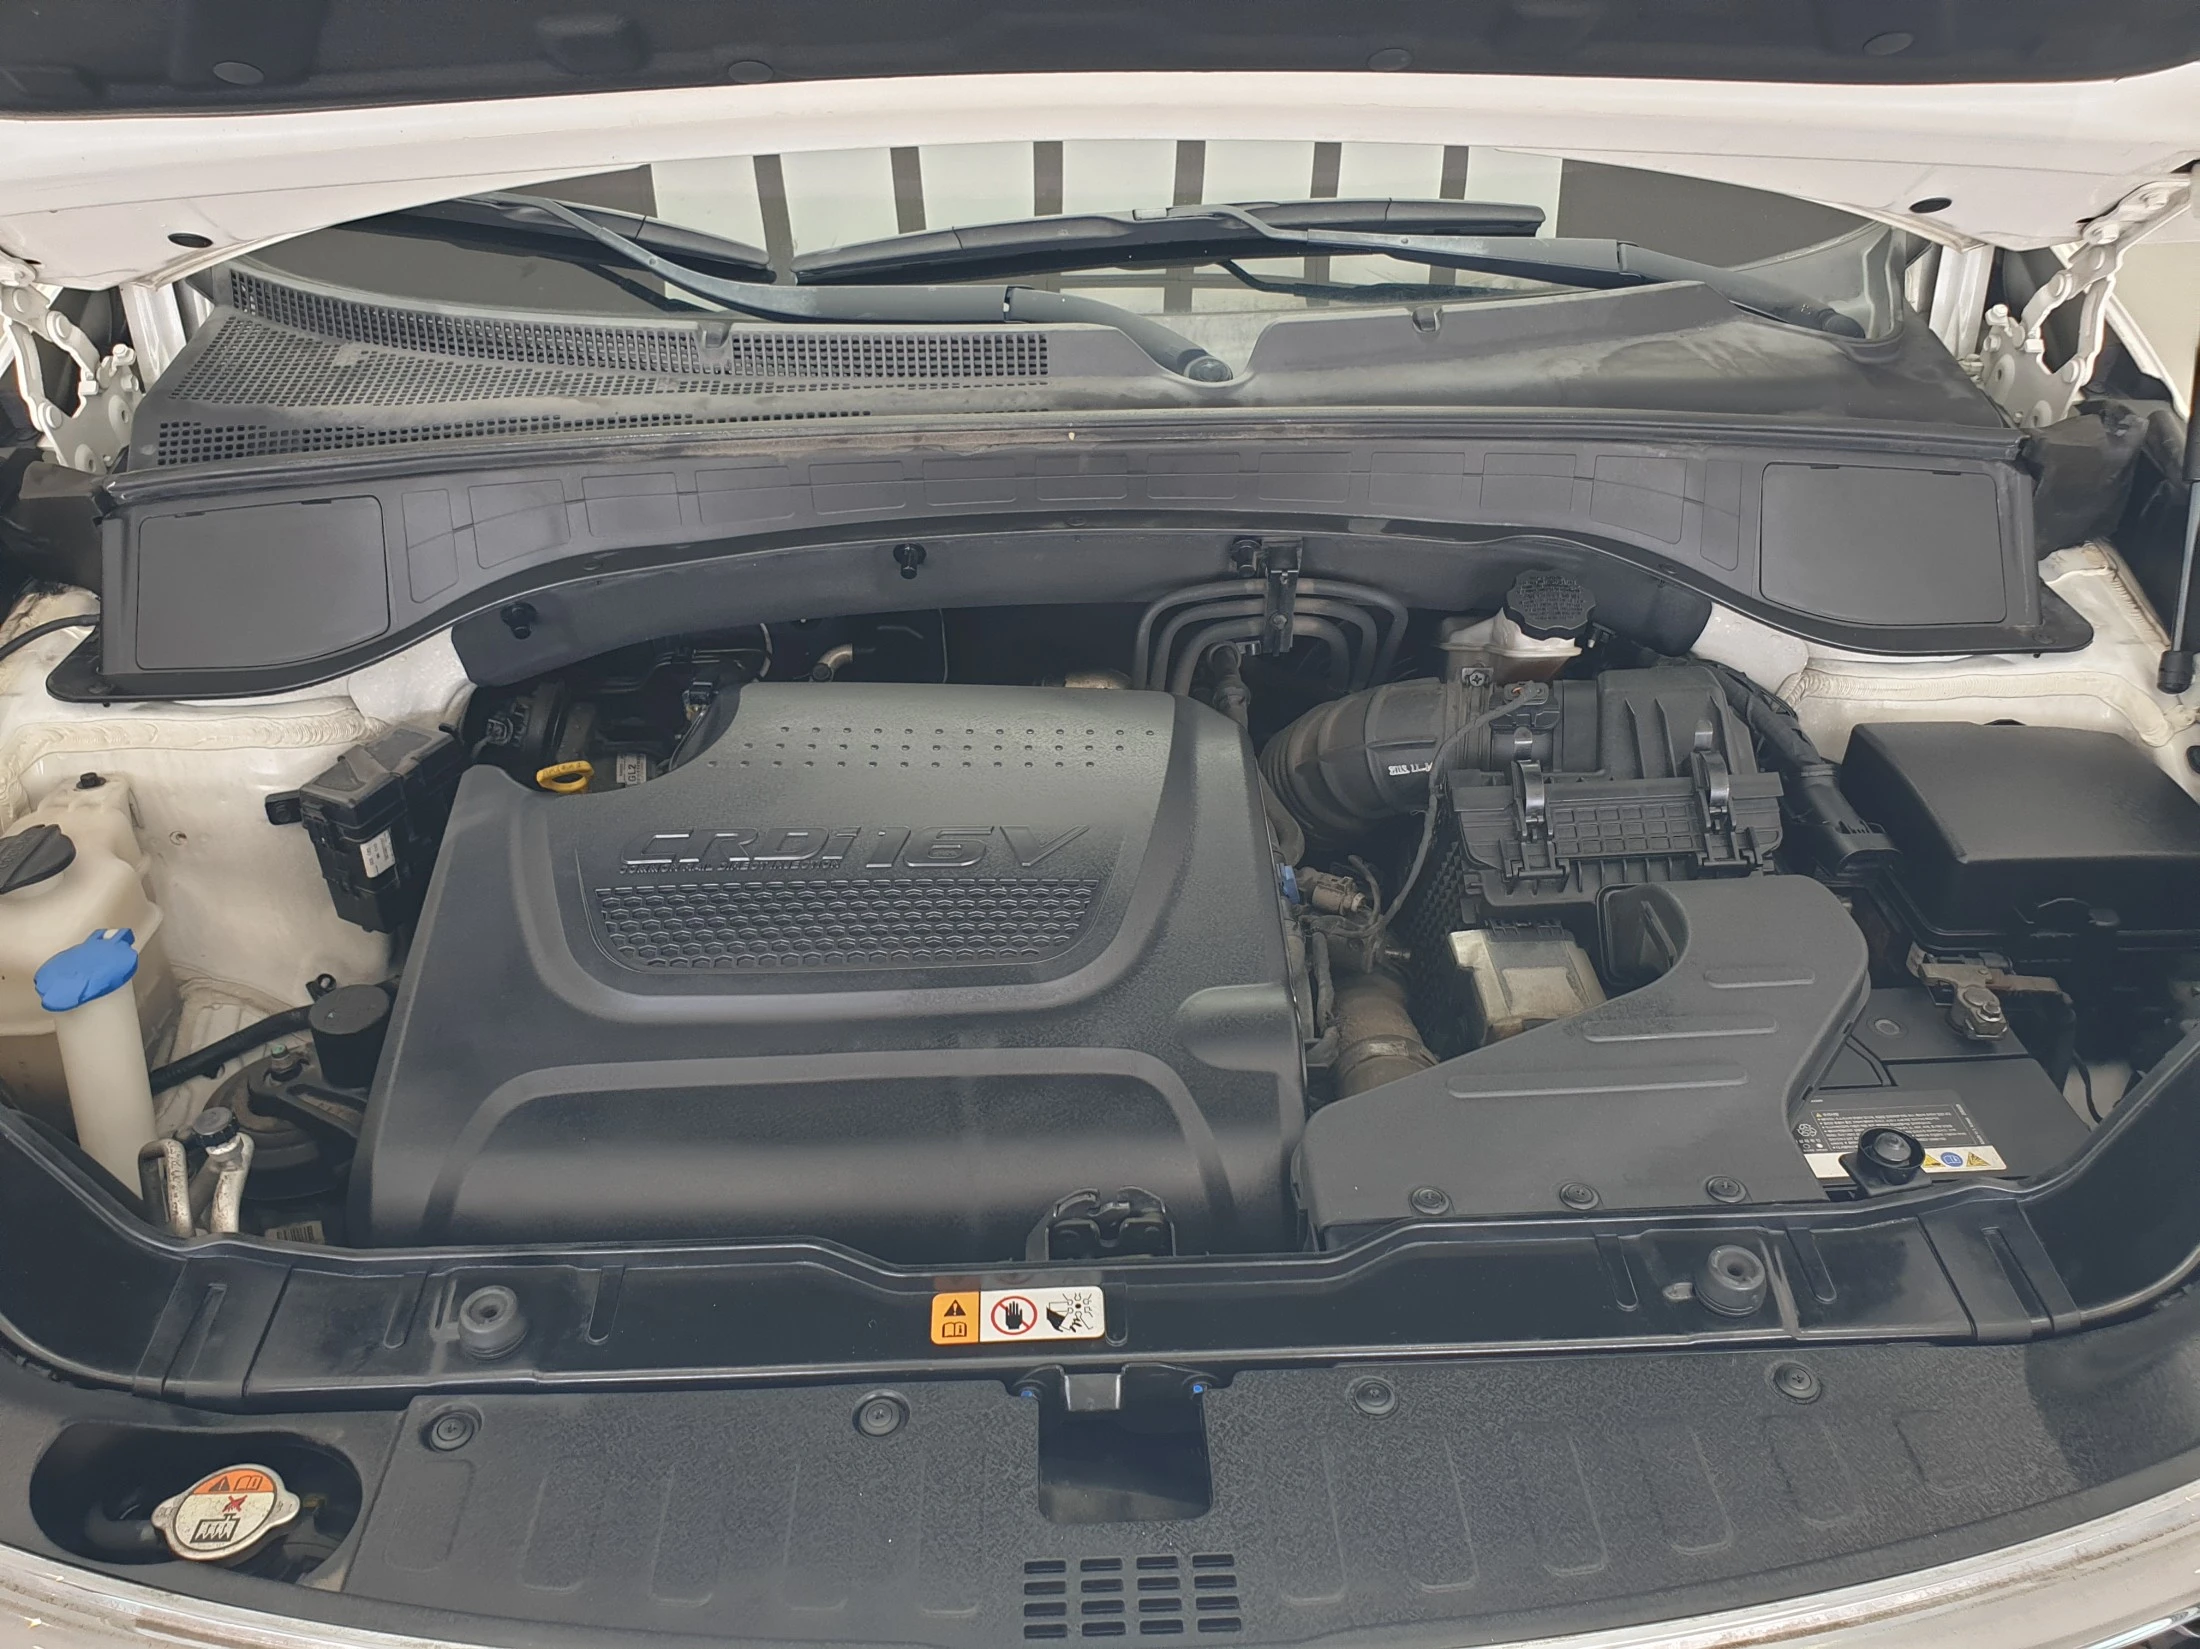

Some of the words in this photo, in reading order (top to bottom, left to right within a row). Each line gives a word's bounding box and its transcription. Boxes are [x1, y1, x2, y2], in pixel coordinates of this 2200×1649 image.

[627, 763, 637, 782] GL2
[866, 825, 1090, 868] 16V
[619, 863, 679, 874] COMMON
[716, 861, 769, 871] DIRECT
[769, 860, 841, 870] INJECTION
